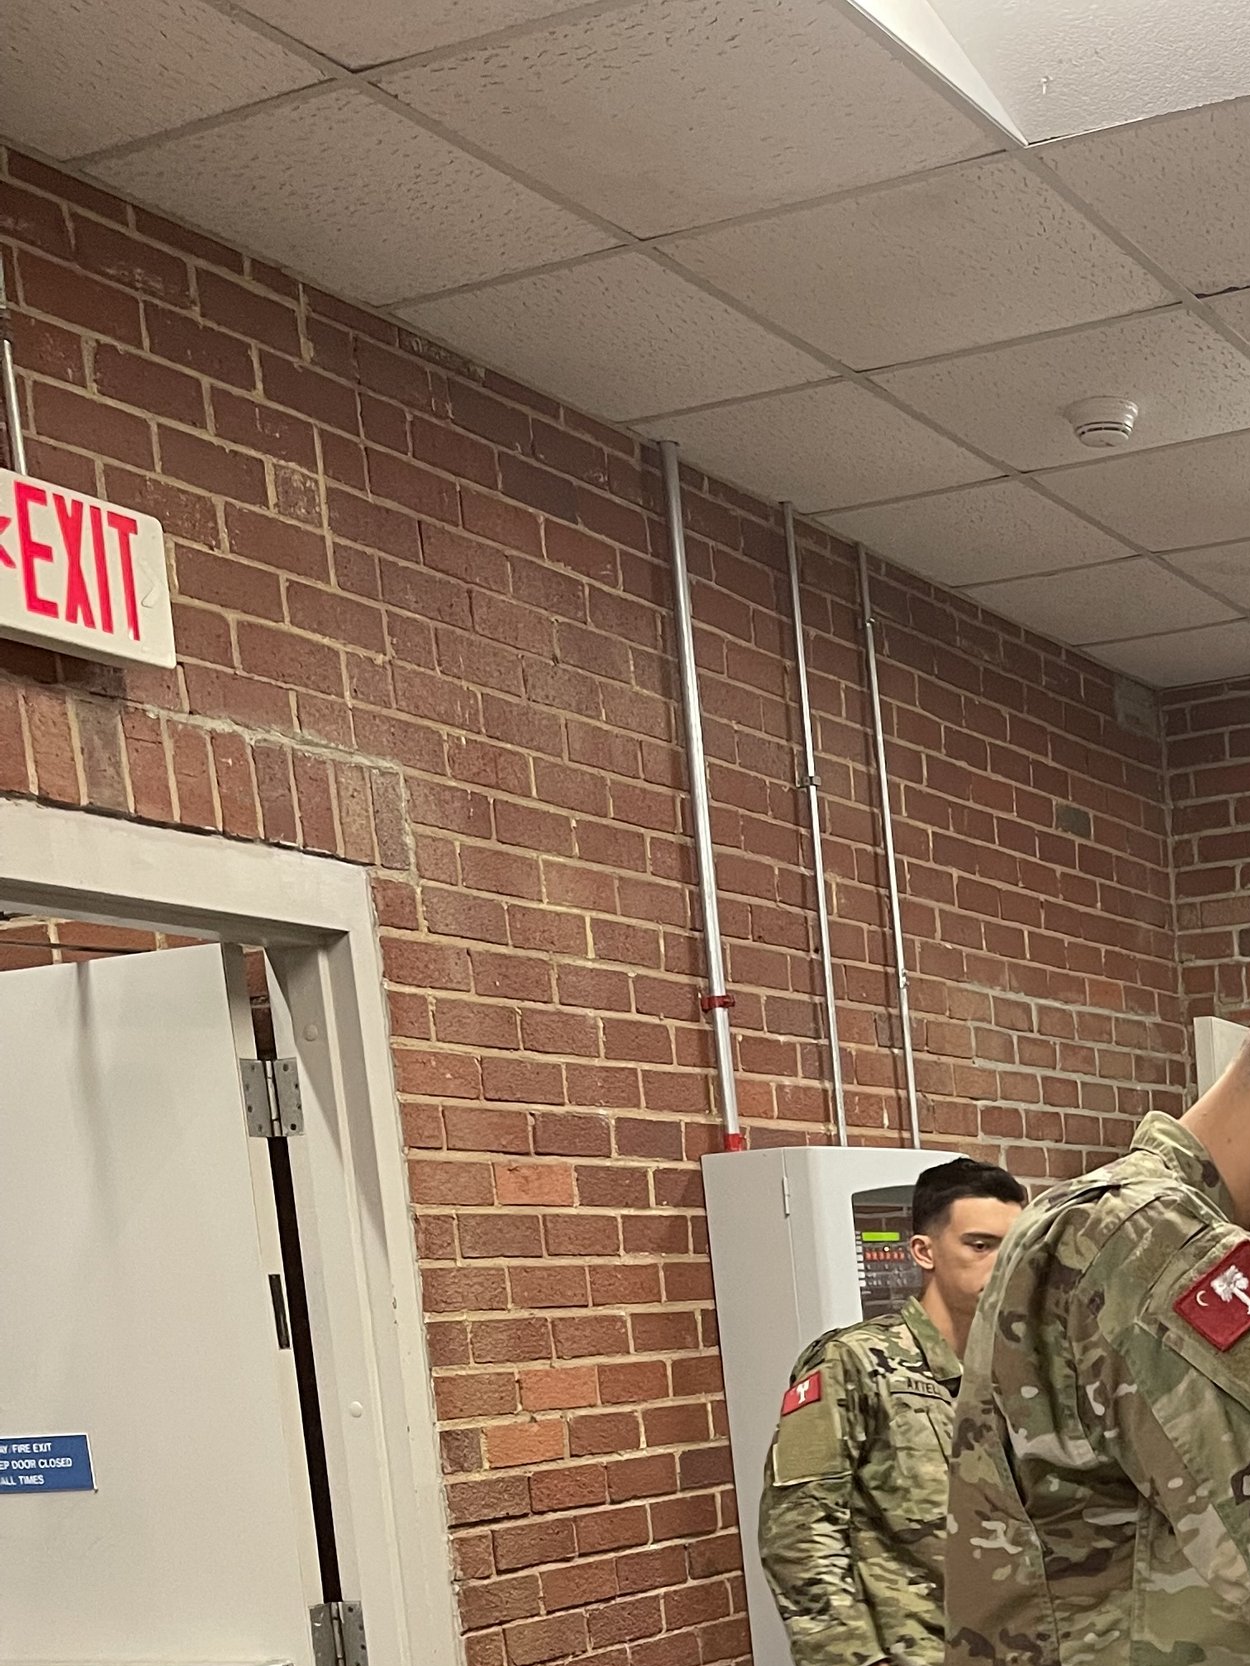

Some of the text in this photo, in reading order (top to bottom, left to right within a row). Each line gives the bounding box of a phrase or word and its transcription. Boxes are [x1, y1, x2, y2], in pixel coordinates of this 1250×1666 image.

[14, 479, 140, 641] EXIT
[12, 1443, 31, 1453] FIRE
[33, 1442, 52, 1453] EXIT
[11, 1459, 37, 1470] DOOR
[38, 1458, 72, 1468] CLOSED
[0, 1474, 45, 1485] ALL TIMES
